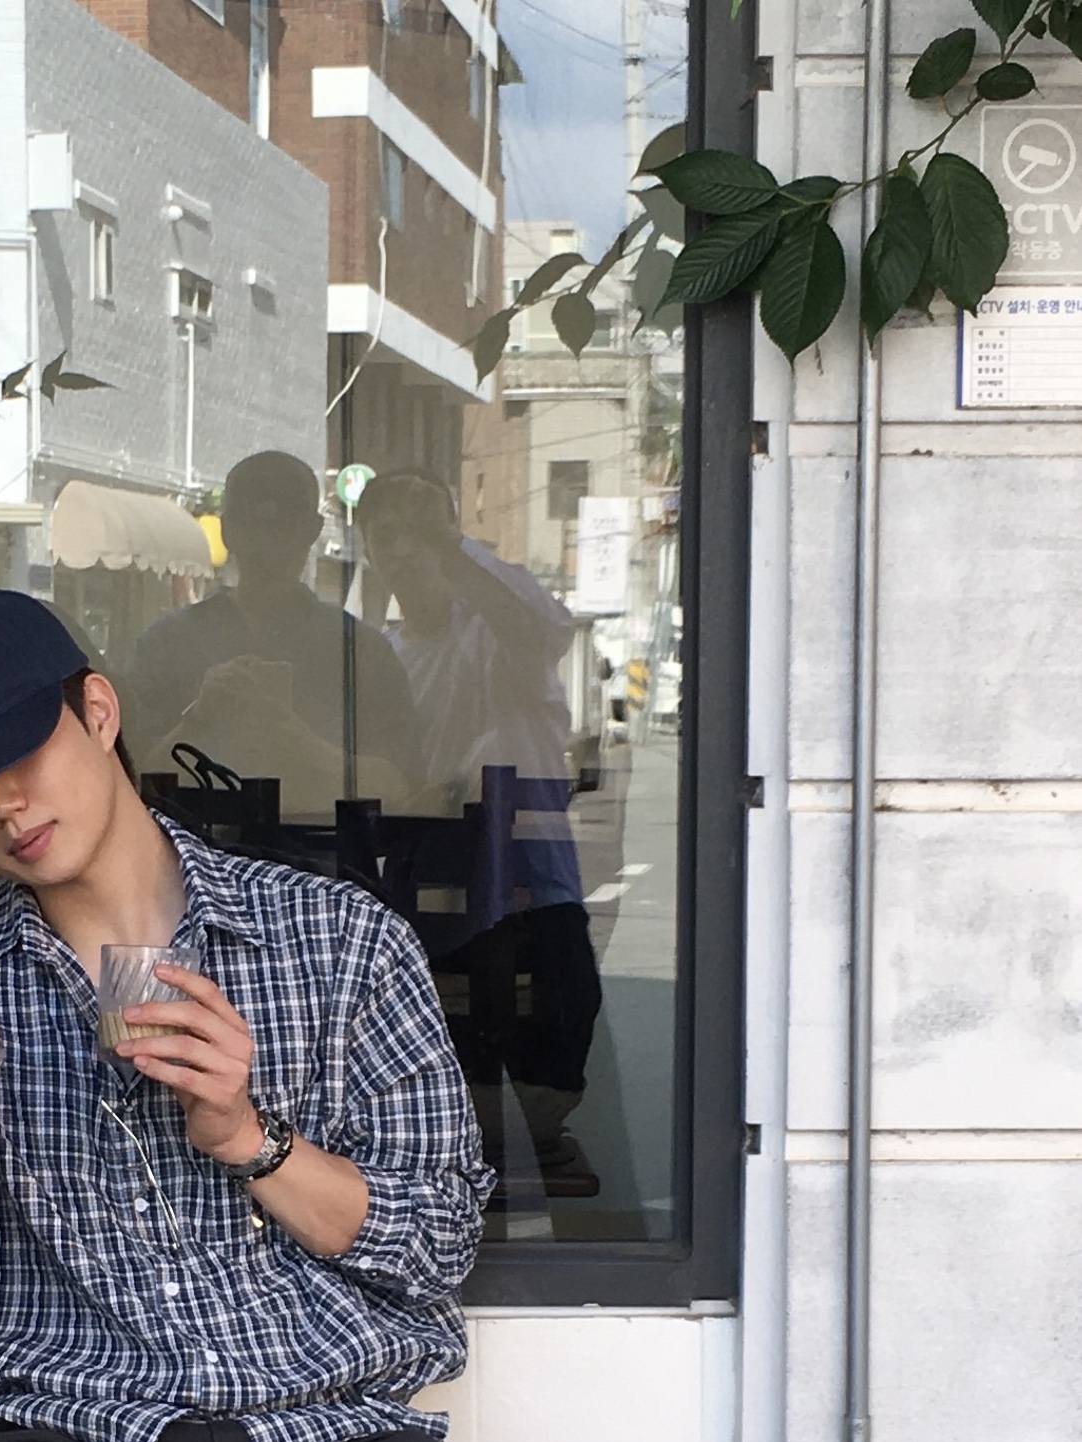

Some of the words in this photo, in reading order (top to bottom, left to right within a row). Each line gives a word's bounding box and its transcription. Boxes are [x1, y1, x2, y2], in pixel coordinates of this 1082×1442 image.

[1002, 203, 1082, 235] CTV
[1011, 240, 1064, 260] 작동중
[977, 300, 1004, 314] CTV
